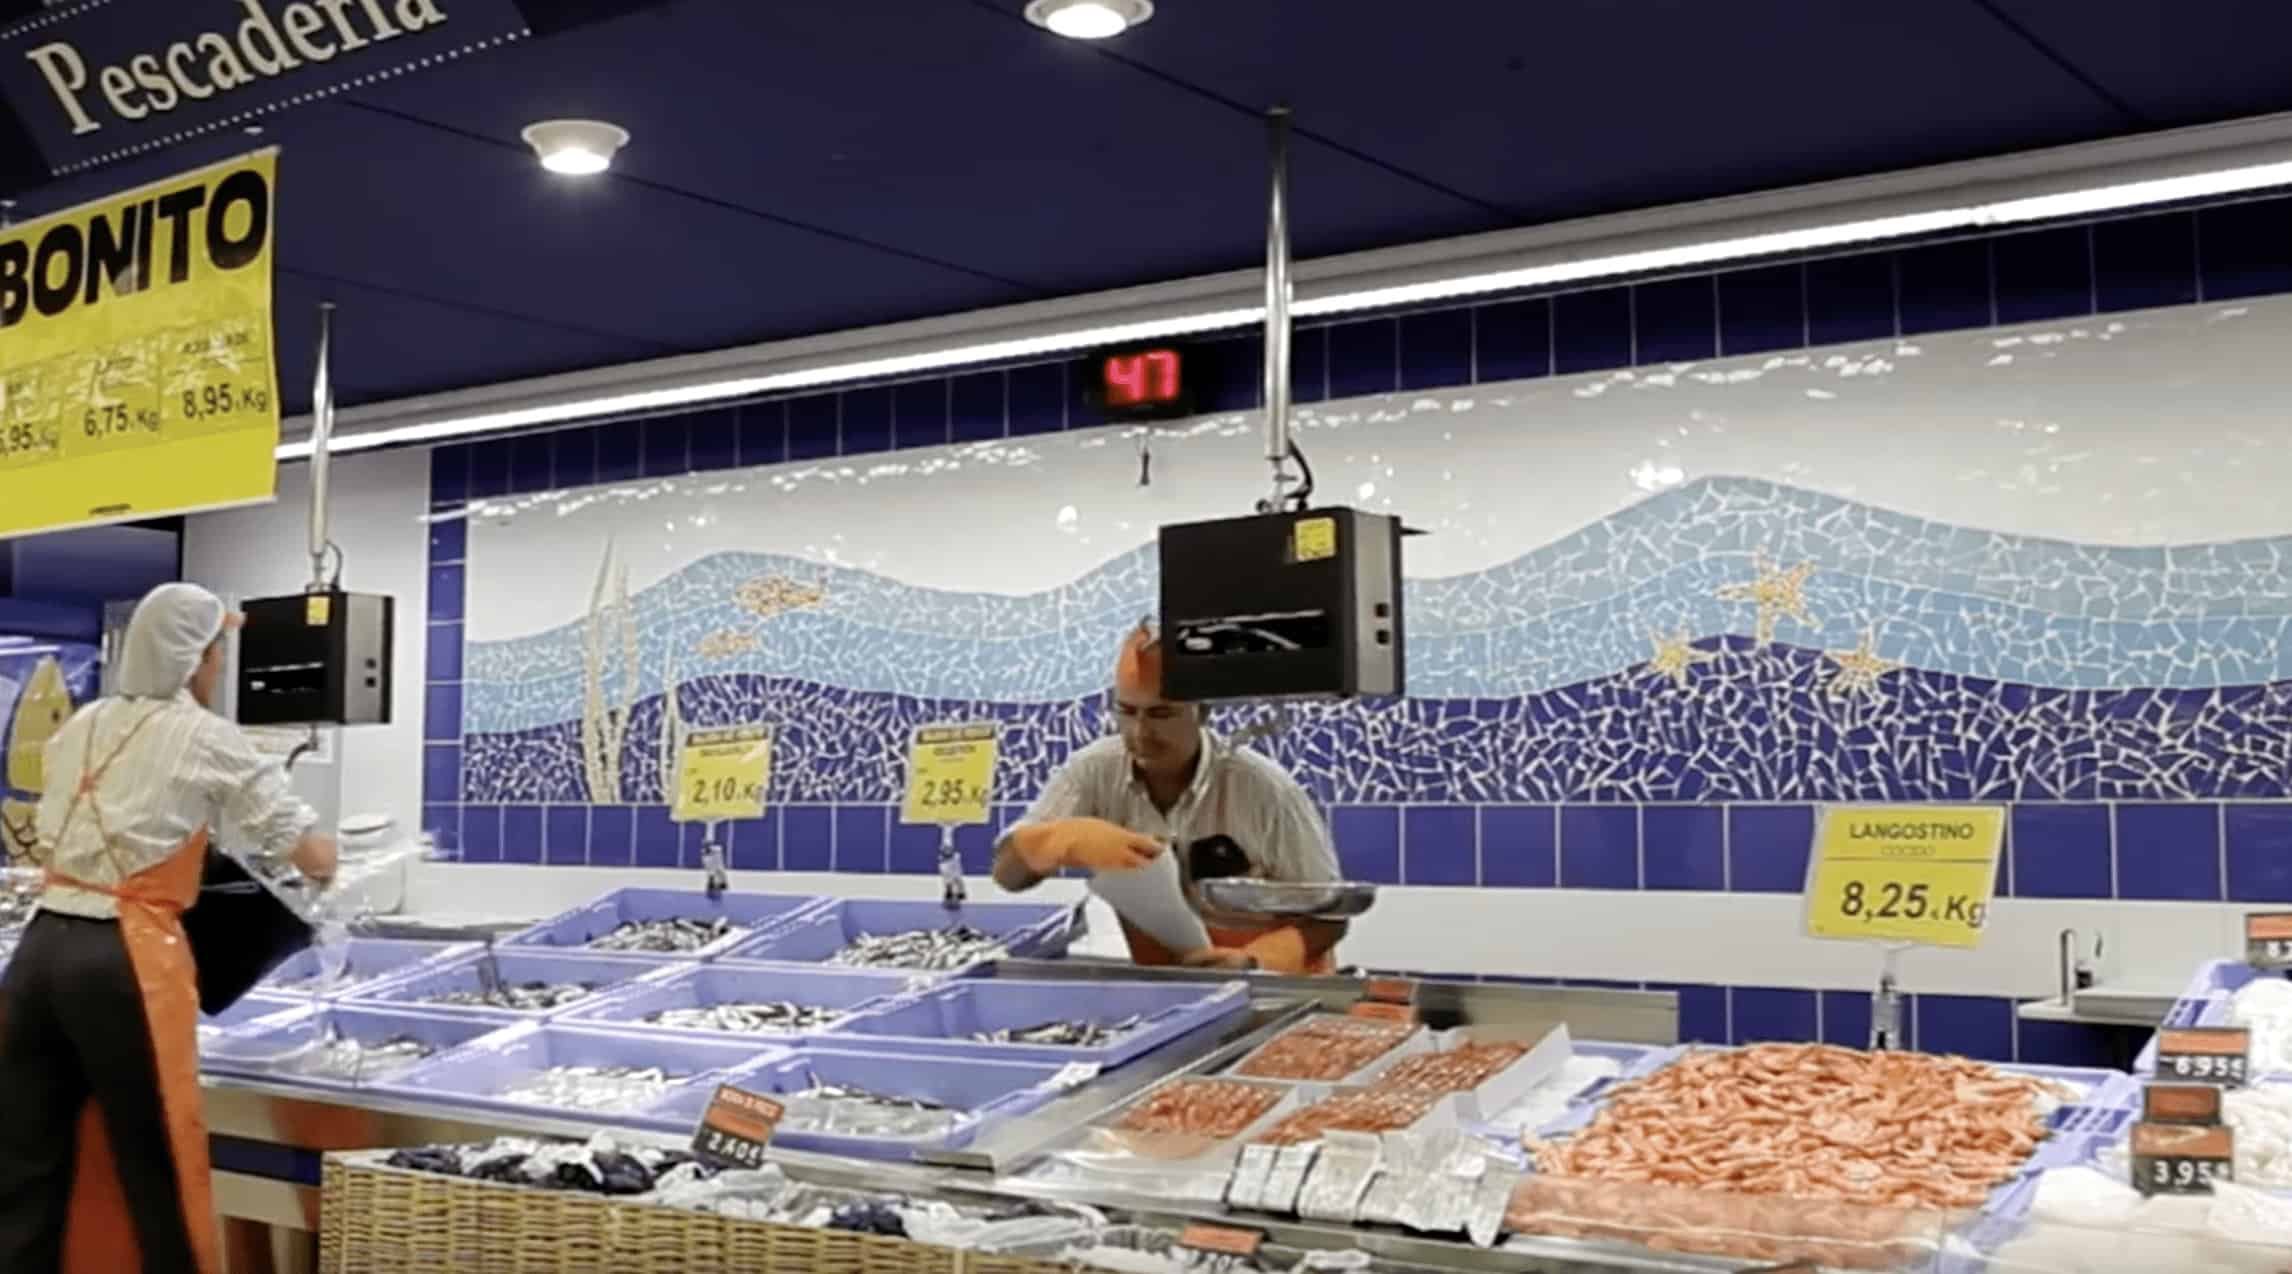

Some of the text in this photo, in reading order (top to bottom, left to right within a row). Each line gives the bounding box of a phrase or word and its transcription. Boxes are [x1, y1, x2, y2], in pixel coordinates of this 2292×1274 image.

[0, 169, 268, 328] BONITO
[1105, 350, 1180, 401] 47
[1850, 823, 1974, 840] LANGOSTINO
[1840, 880, 1929, 923] 8,25
